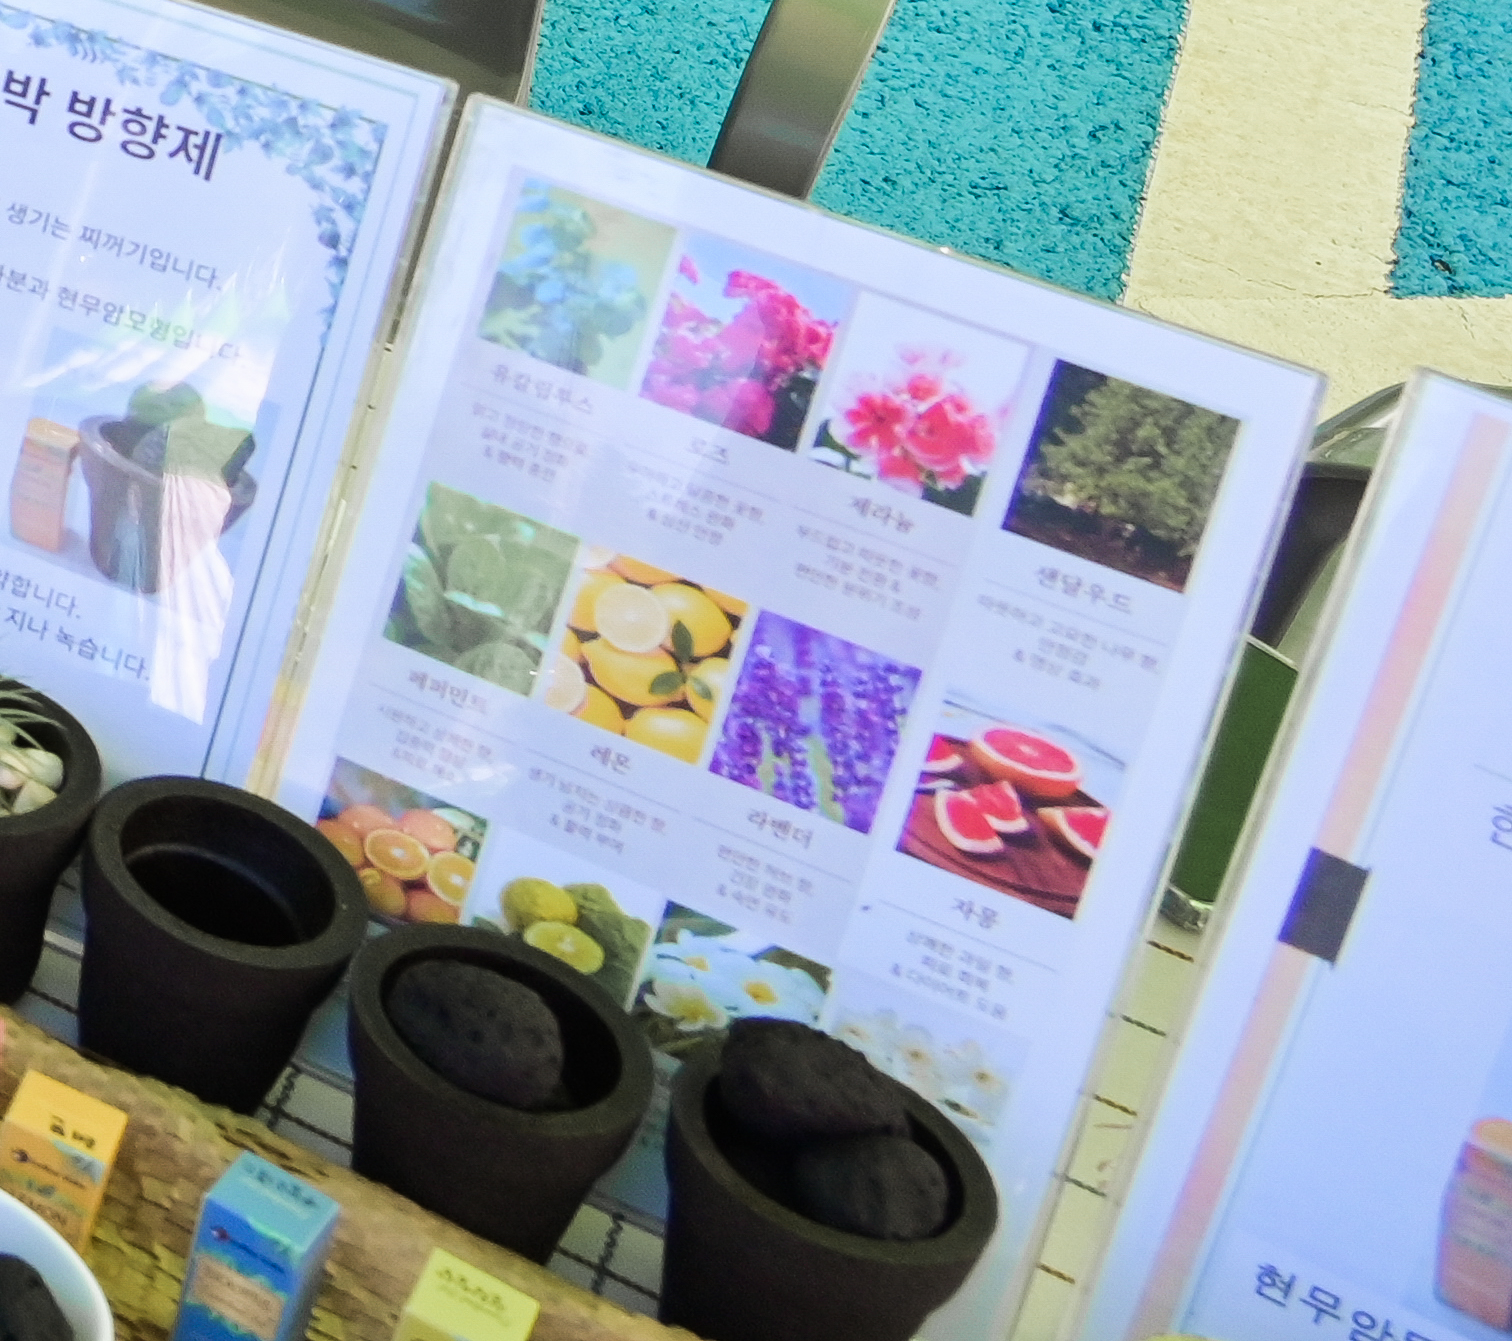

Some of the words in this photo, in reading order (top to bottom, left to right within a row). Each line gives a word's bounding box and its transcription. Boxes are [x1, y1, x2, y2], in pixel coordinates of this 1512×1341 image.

[65, 90, 224, 182] 방향제
[7, 202, 71, 241] 생기는
[5, 605, 50, 641] 지나
